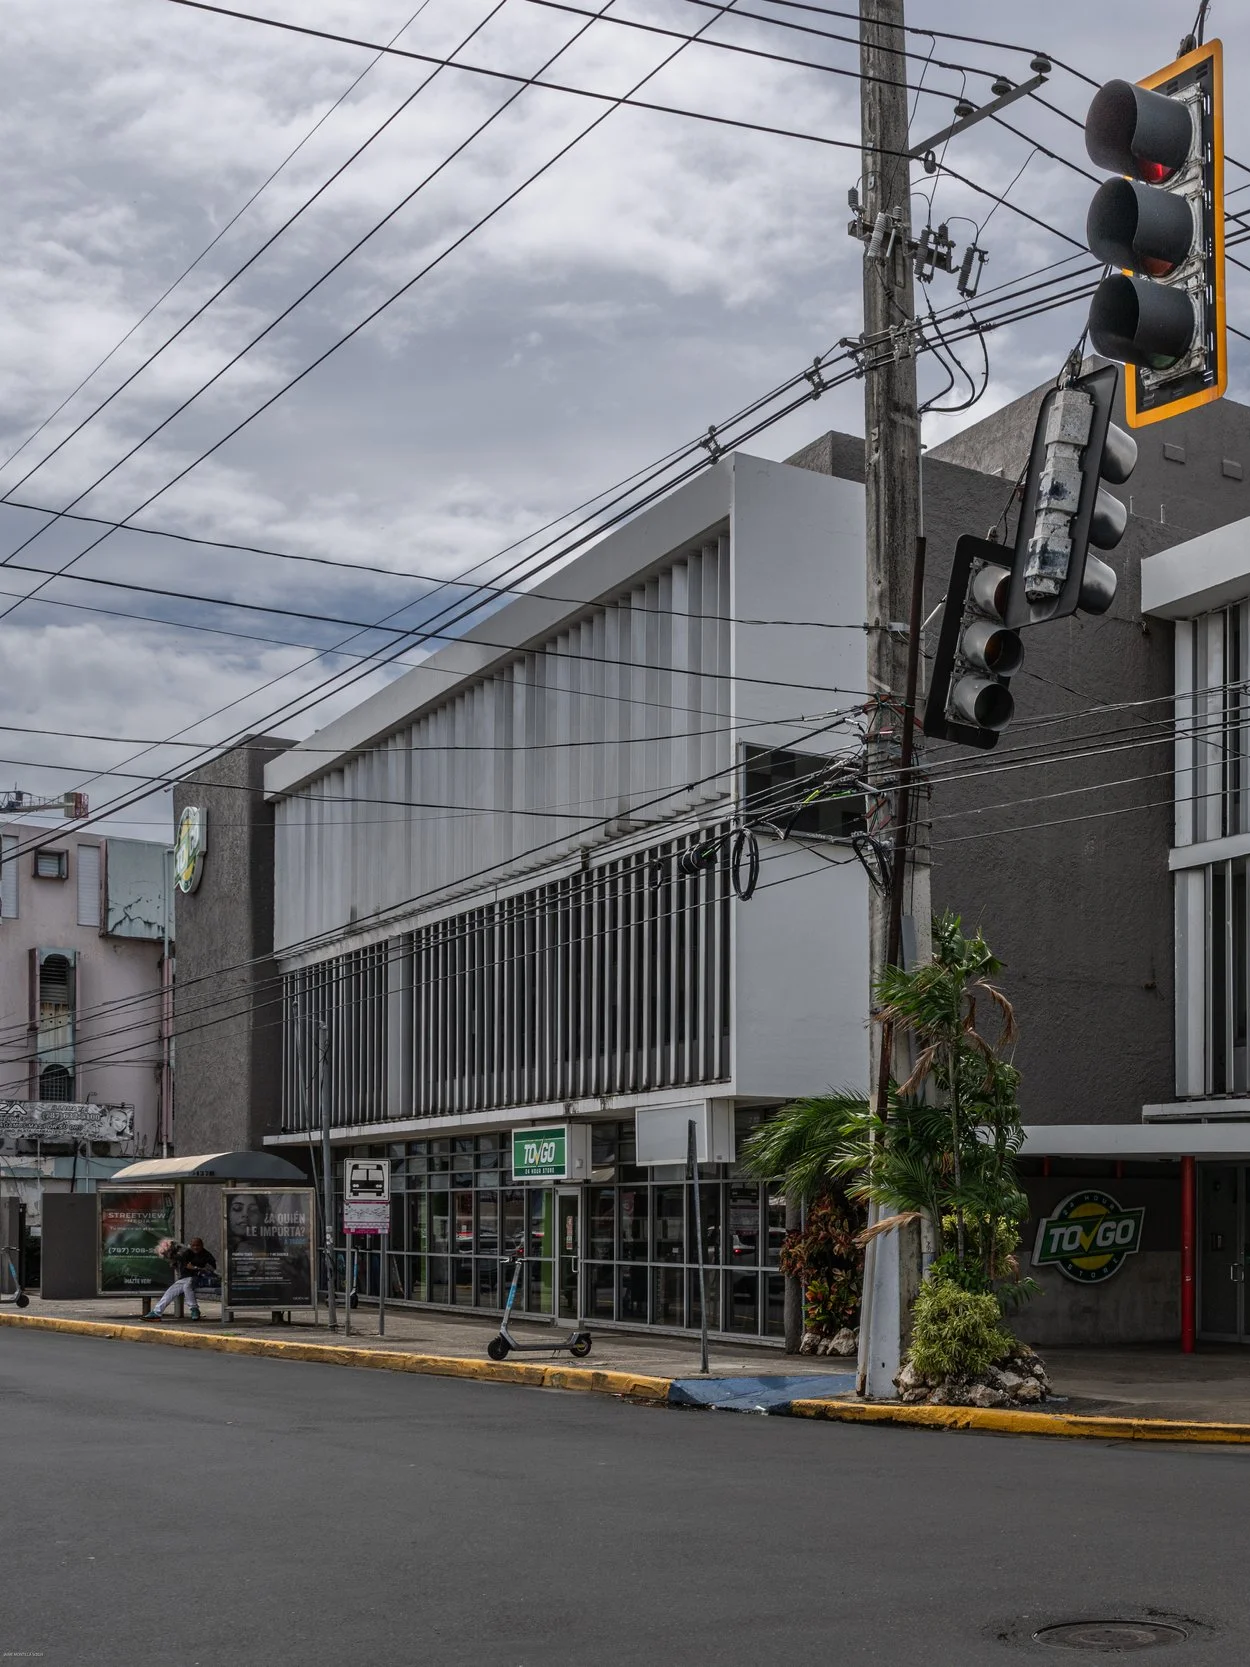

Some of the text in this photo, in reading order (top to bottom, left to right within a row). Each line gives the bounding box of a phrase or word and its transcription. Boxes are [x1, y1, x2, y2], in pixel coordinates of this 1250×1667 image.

[524, 1142, 555, 1165] TO GO
[1084, 1196, 1115, 1210] HOUR
[264, 1210, 306, 1225] ¿A QUIÉN
[246, 1226, 306, 1237] LE IMPORTA?
[1049, 1219, 1135, 1253] TO GO
[1068, 1258, 1119, 1277] STORE
